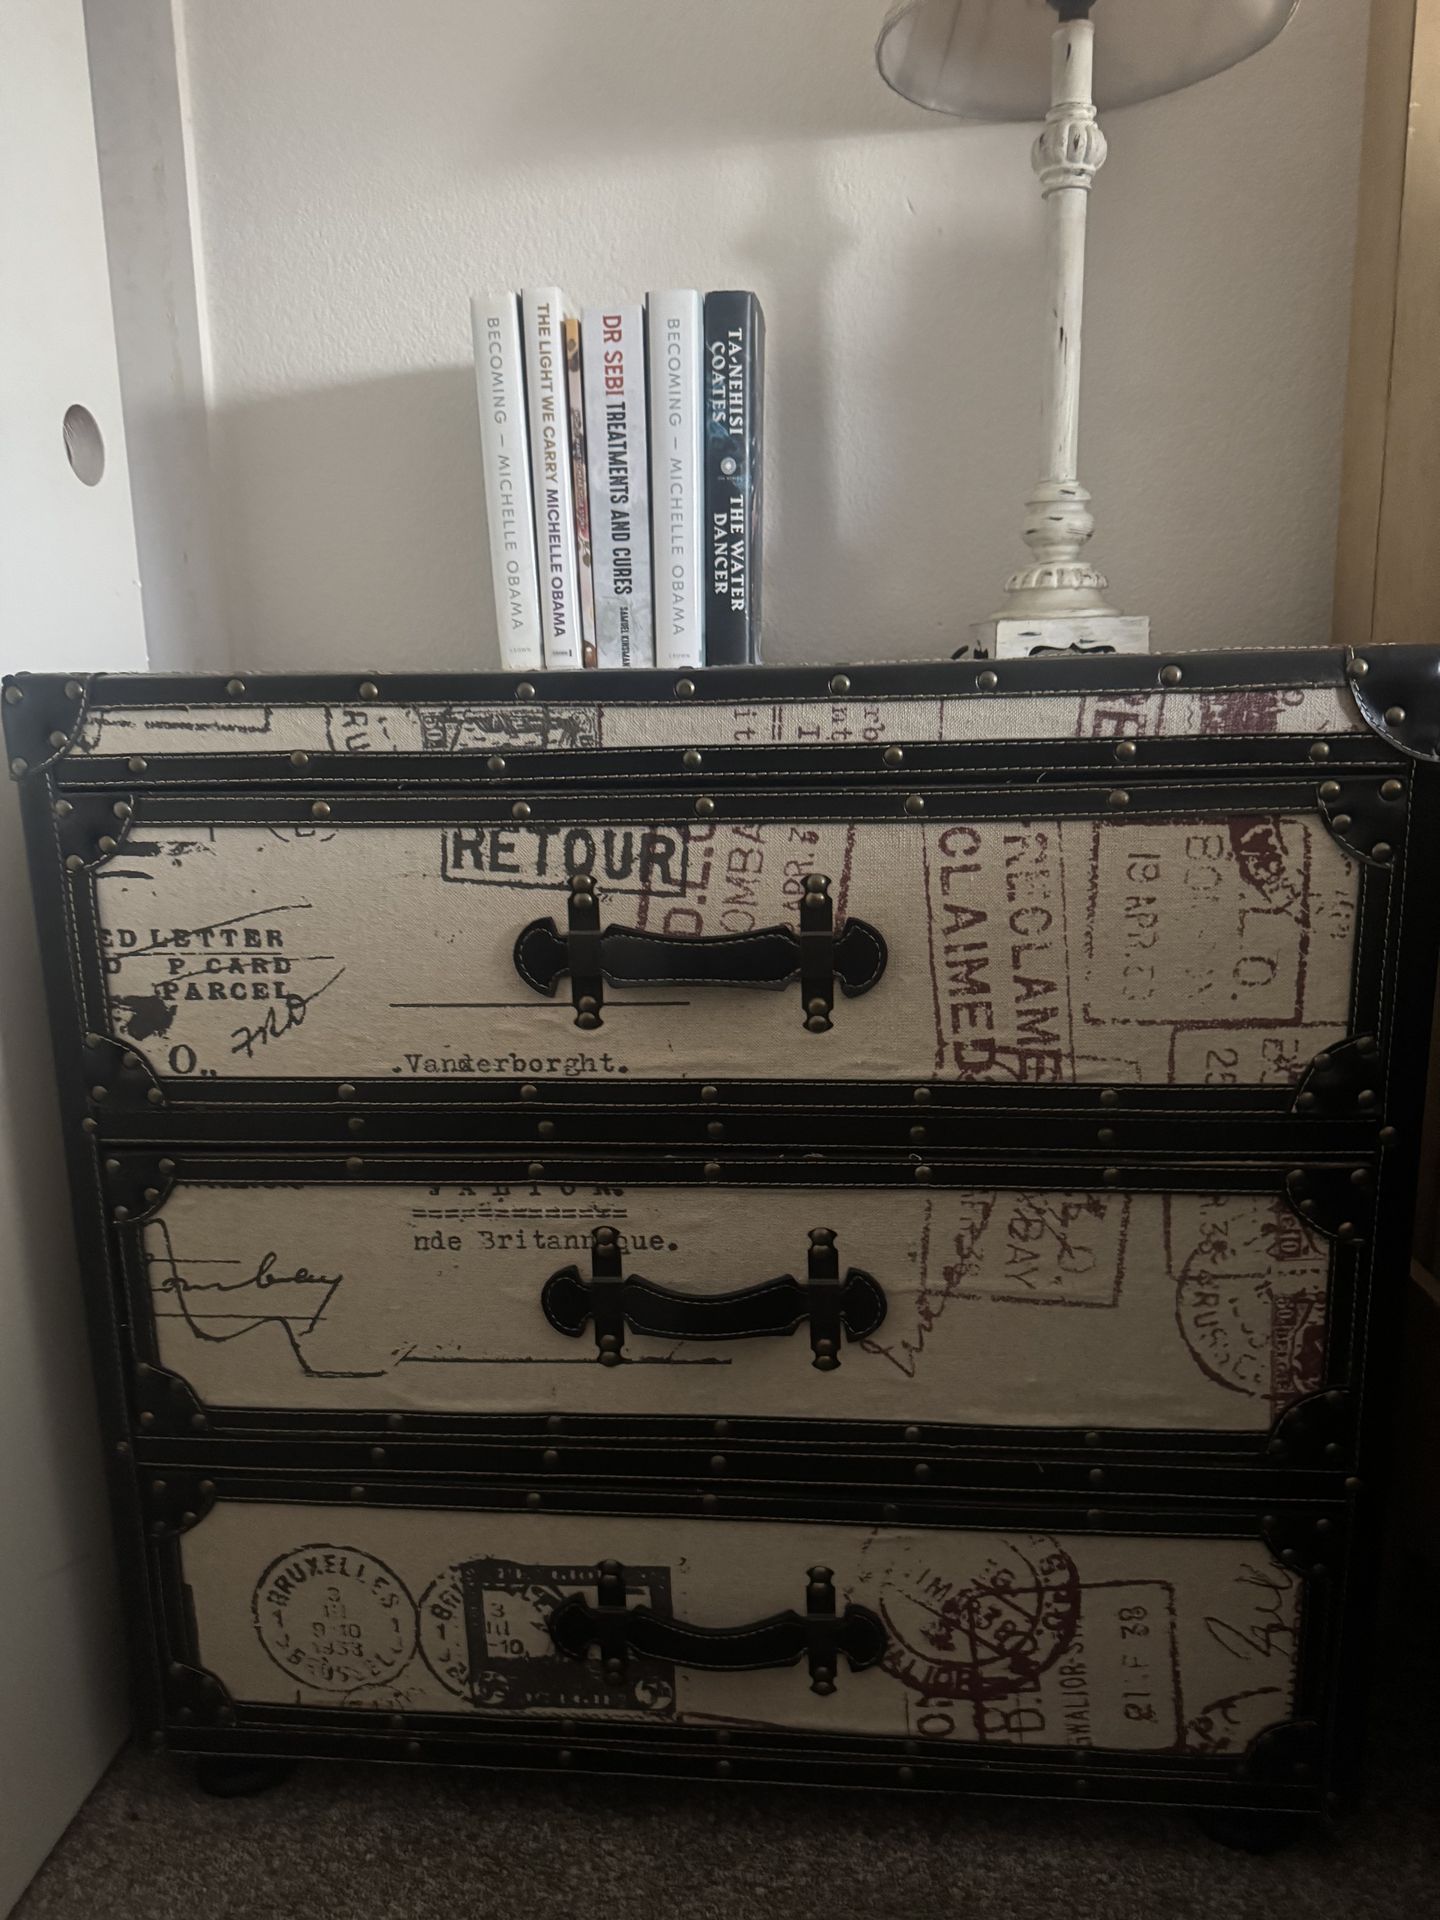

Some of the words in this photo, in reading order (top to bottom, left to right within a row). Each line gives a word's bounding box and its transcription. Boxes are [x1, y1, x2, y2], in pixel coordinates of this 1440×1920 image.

[537, 303, 551, 337] THE
[602, 315, 622, 343] DR
[487, 317, 507, 424] BECOMING
[539, 341, 553, 390] LIGHT
[604, 351, 624, 396] SEBI
[667, 318, 682, 427] BECOMING
[711, 341, 726, 423] COATES
[728, 327, 744, 436] TA-NEHISI
[541, 397, 556, 422] WE
[543, 426, 558, 483] CARRY
[606, 402, 630, 504] TREATMENTS
[498, 455, 518, 550] MICHELLE
[546, 489, 563, 573] MICHELLE
[610, 510, 630, 541] AND
[670, 458, 684, 555] MICHELLE
[730, 494, 744, 534] THE
[613, 549, 632, 595] CURES
[713, 513, 728, 595] DANCER
[730, 540, 745, 612] WATER
[506, 560, 524, 630] OBAMA
[551, 577, 566, 637] OBAMA
[672, 565, 685, 636] OBAMA
[452, 824, 677, 885] RETOUR
[151, 928, 284, 948] LETTER
[205, 957, 292, 975] CARD
[161, 981, 292, 1001] PARCEL
